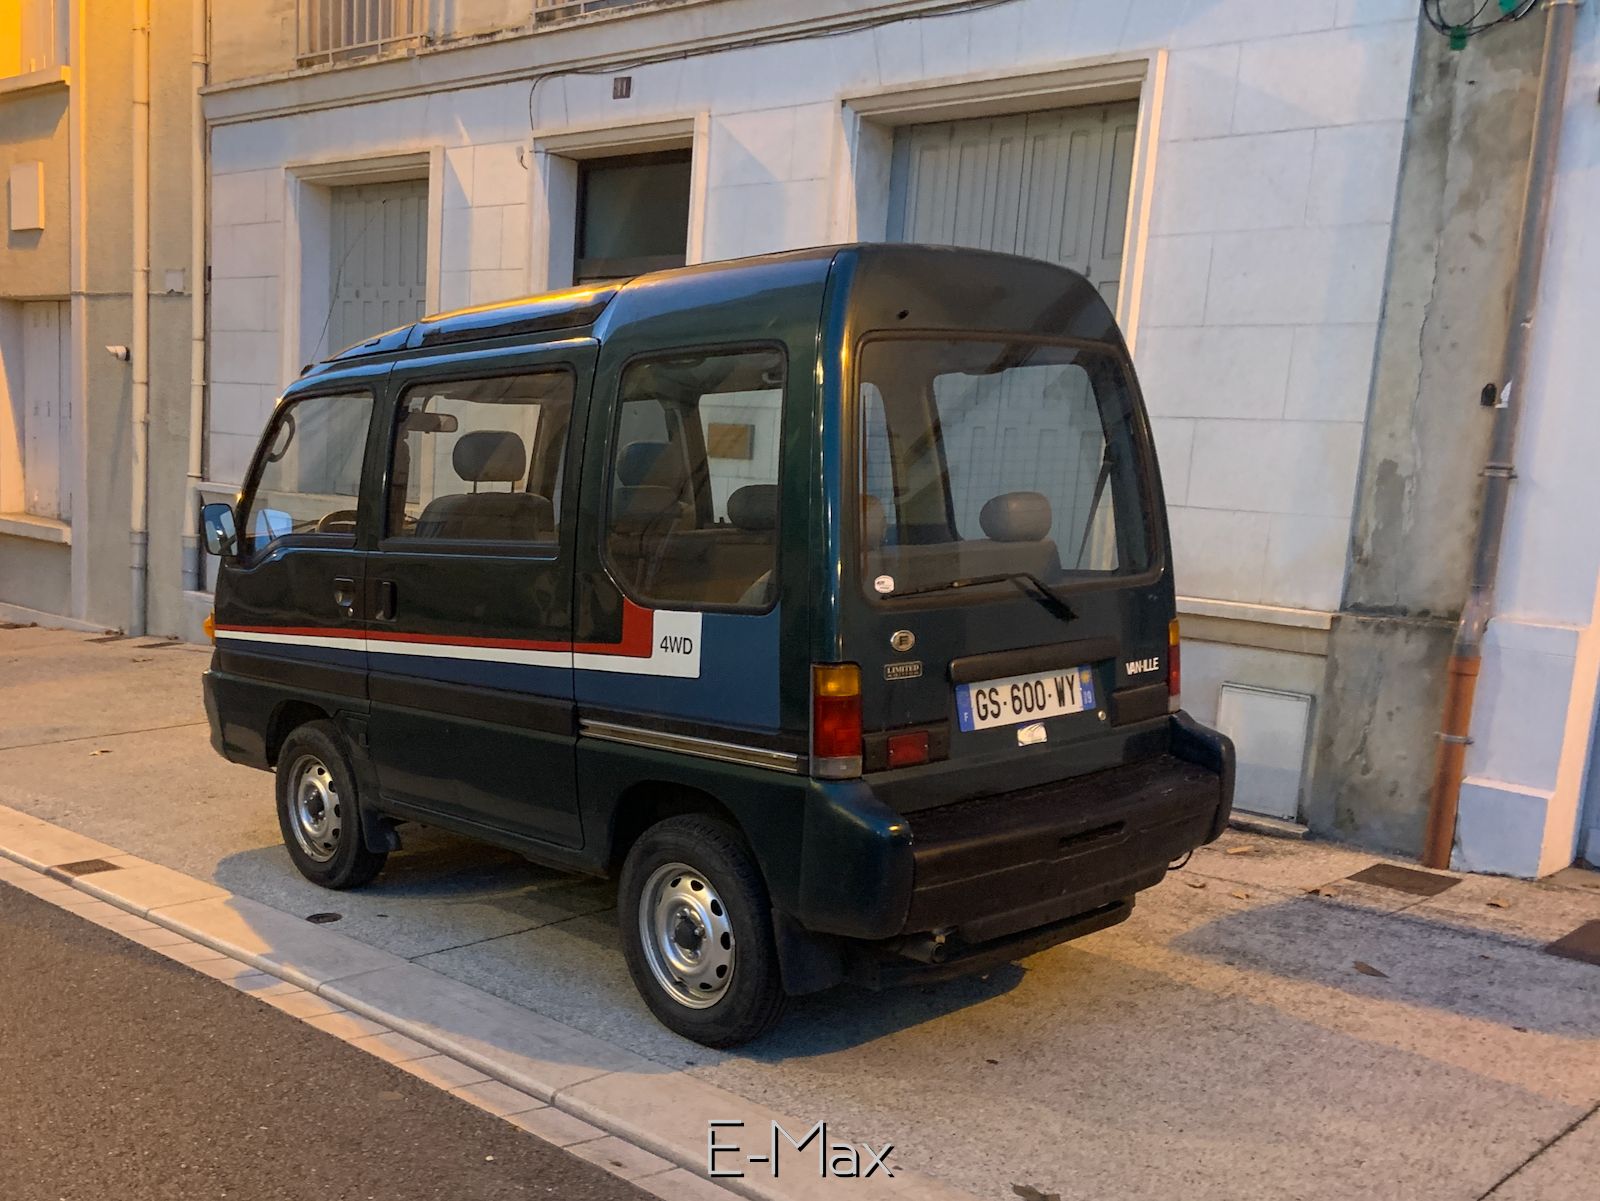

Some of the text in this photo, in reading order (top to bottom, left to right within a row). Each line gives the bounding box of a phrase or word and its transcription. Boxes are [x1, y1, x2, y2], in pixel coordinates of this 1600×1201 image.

[660, 635, 693, 655] 4WD
[887, 664, 919, 674] LIMITED
[963, 711, 969, 722] F
